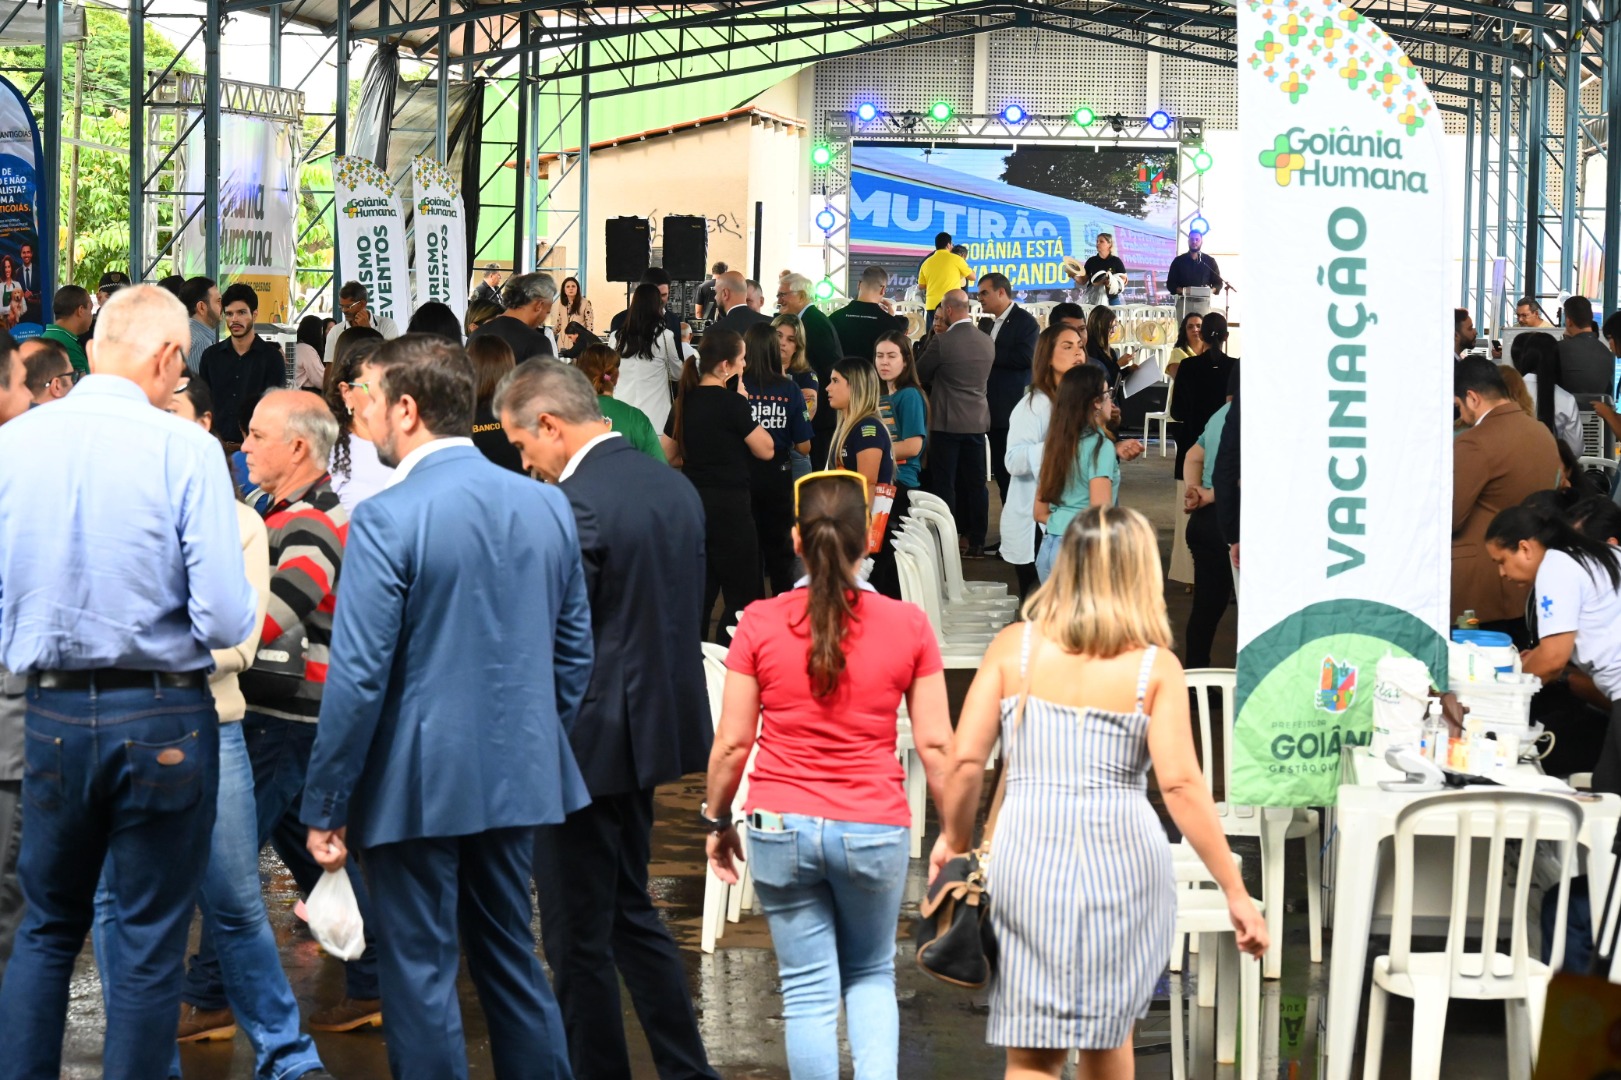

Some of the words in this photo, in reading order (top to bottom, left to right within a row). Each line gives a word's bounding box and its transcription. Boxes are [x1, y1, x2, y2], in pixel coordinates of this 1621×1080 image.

[1285, 126, 1403, 160] Goiânia
[2, 167, 12, 176] DE
[1300, 159, 1429, 194] Humana
[9, 174, 27, 184] NÃO
[352, 196, 389, 208] Goiânia
[424, 196, 451, 208] Goiânia
[355, 206, 397, 218] Humana
[427, 207, 458, 218] Humana
[850, 184, 1059, 239] MUTIRÃO
[1026, 236, 1065, 258] ESTÁ
[440, 224, 452, 308] VENTOS
[967, 262, 1071, 290] VANÇANDO
[748, 394, 789, 403] READOR
[1316, 206, 1379, 579] VACINAÇÃO
[472, 422, 501, 433] BANCO
[1271, 725, 1374, 761] GOIÂNI
[1269, 763, 1317, 774] GESTÃO
